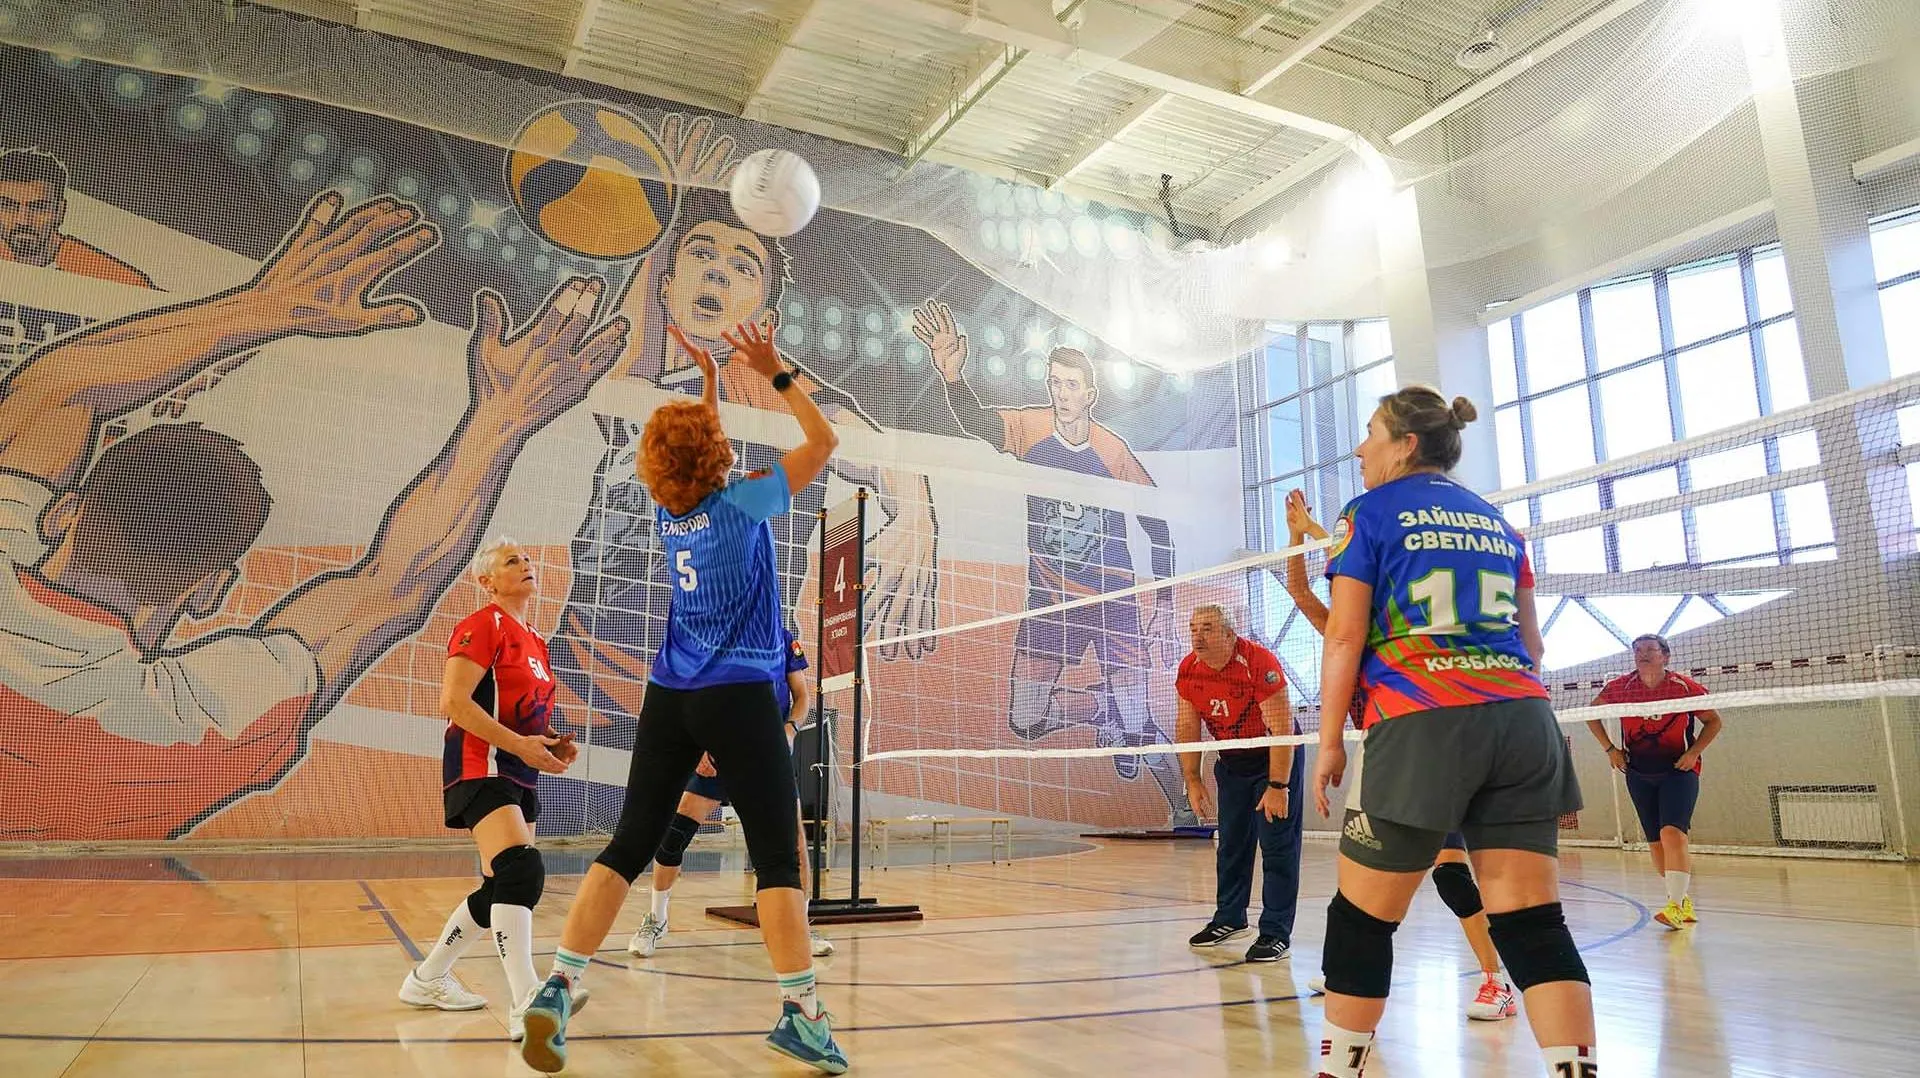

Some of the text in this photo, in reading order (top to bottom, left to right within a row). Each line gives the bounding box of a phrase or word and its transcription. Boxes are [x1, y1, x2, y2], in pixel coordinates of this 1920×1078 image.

[1398, 505, 1506, 537] ЗАЙЦЕВА
[676, 550, 698, 592] 5
[834, 556, 847, 602] 4
[1408, 567, 1520, 636] 15
[1209, 699, 1229, 717] 21
